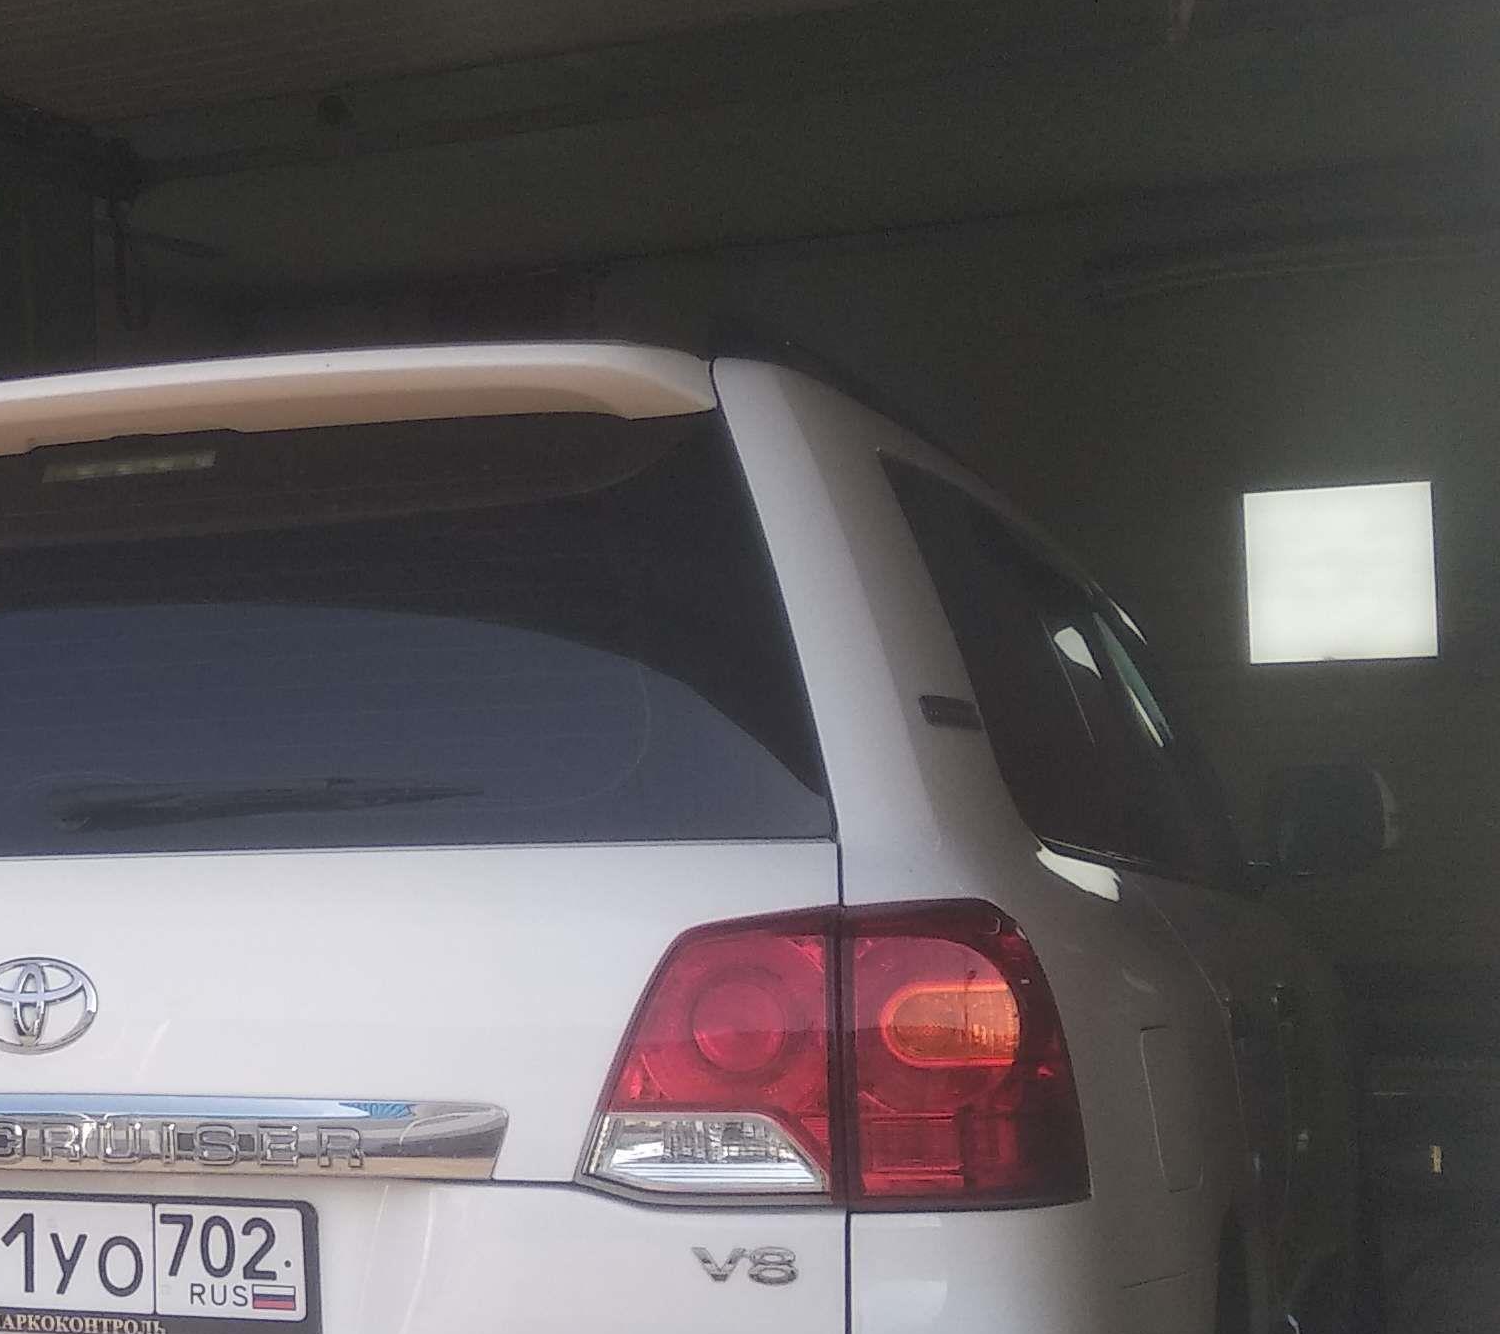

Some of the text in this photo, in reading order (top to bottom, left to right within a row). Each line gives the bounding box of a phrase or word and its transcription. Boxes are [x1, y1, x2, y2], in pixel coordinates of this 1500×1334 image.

[159, 1213, 277, 1281] 702
[691, 1245, 800, 1286] V8
[190, 1282, 249, 1307] RUS
